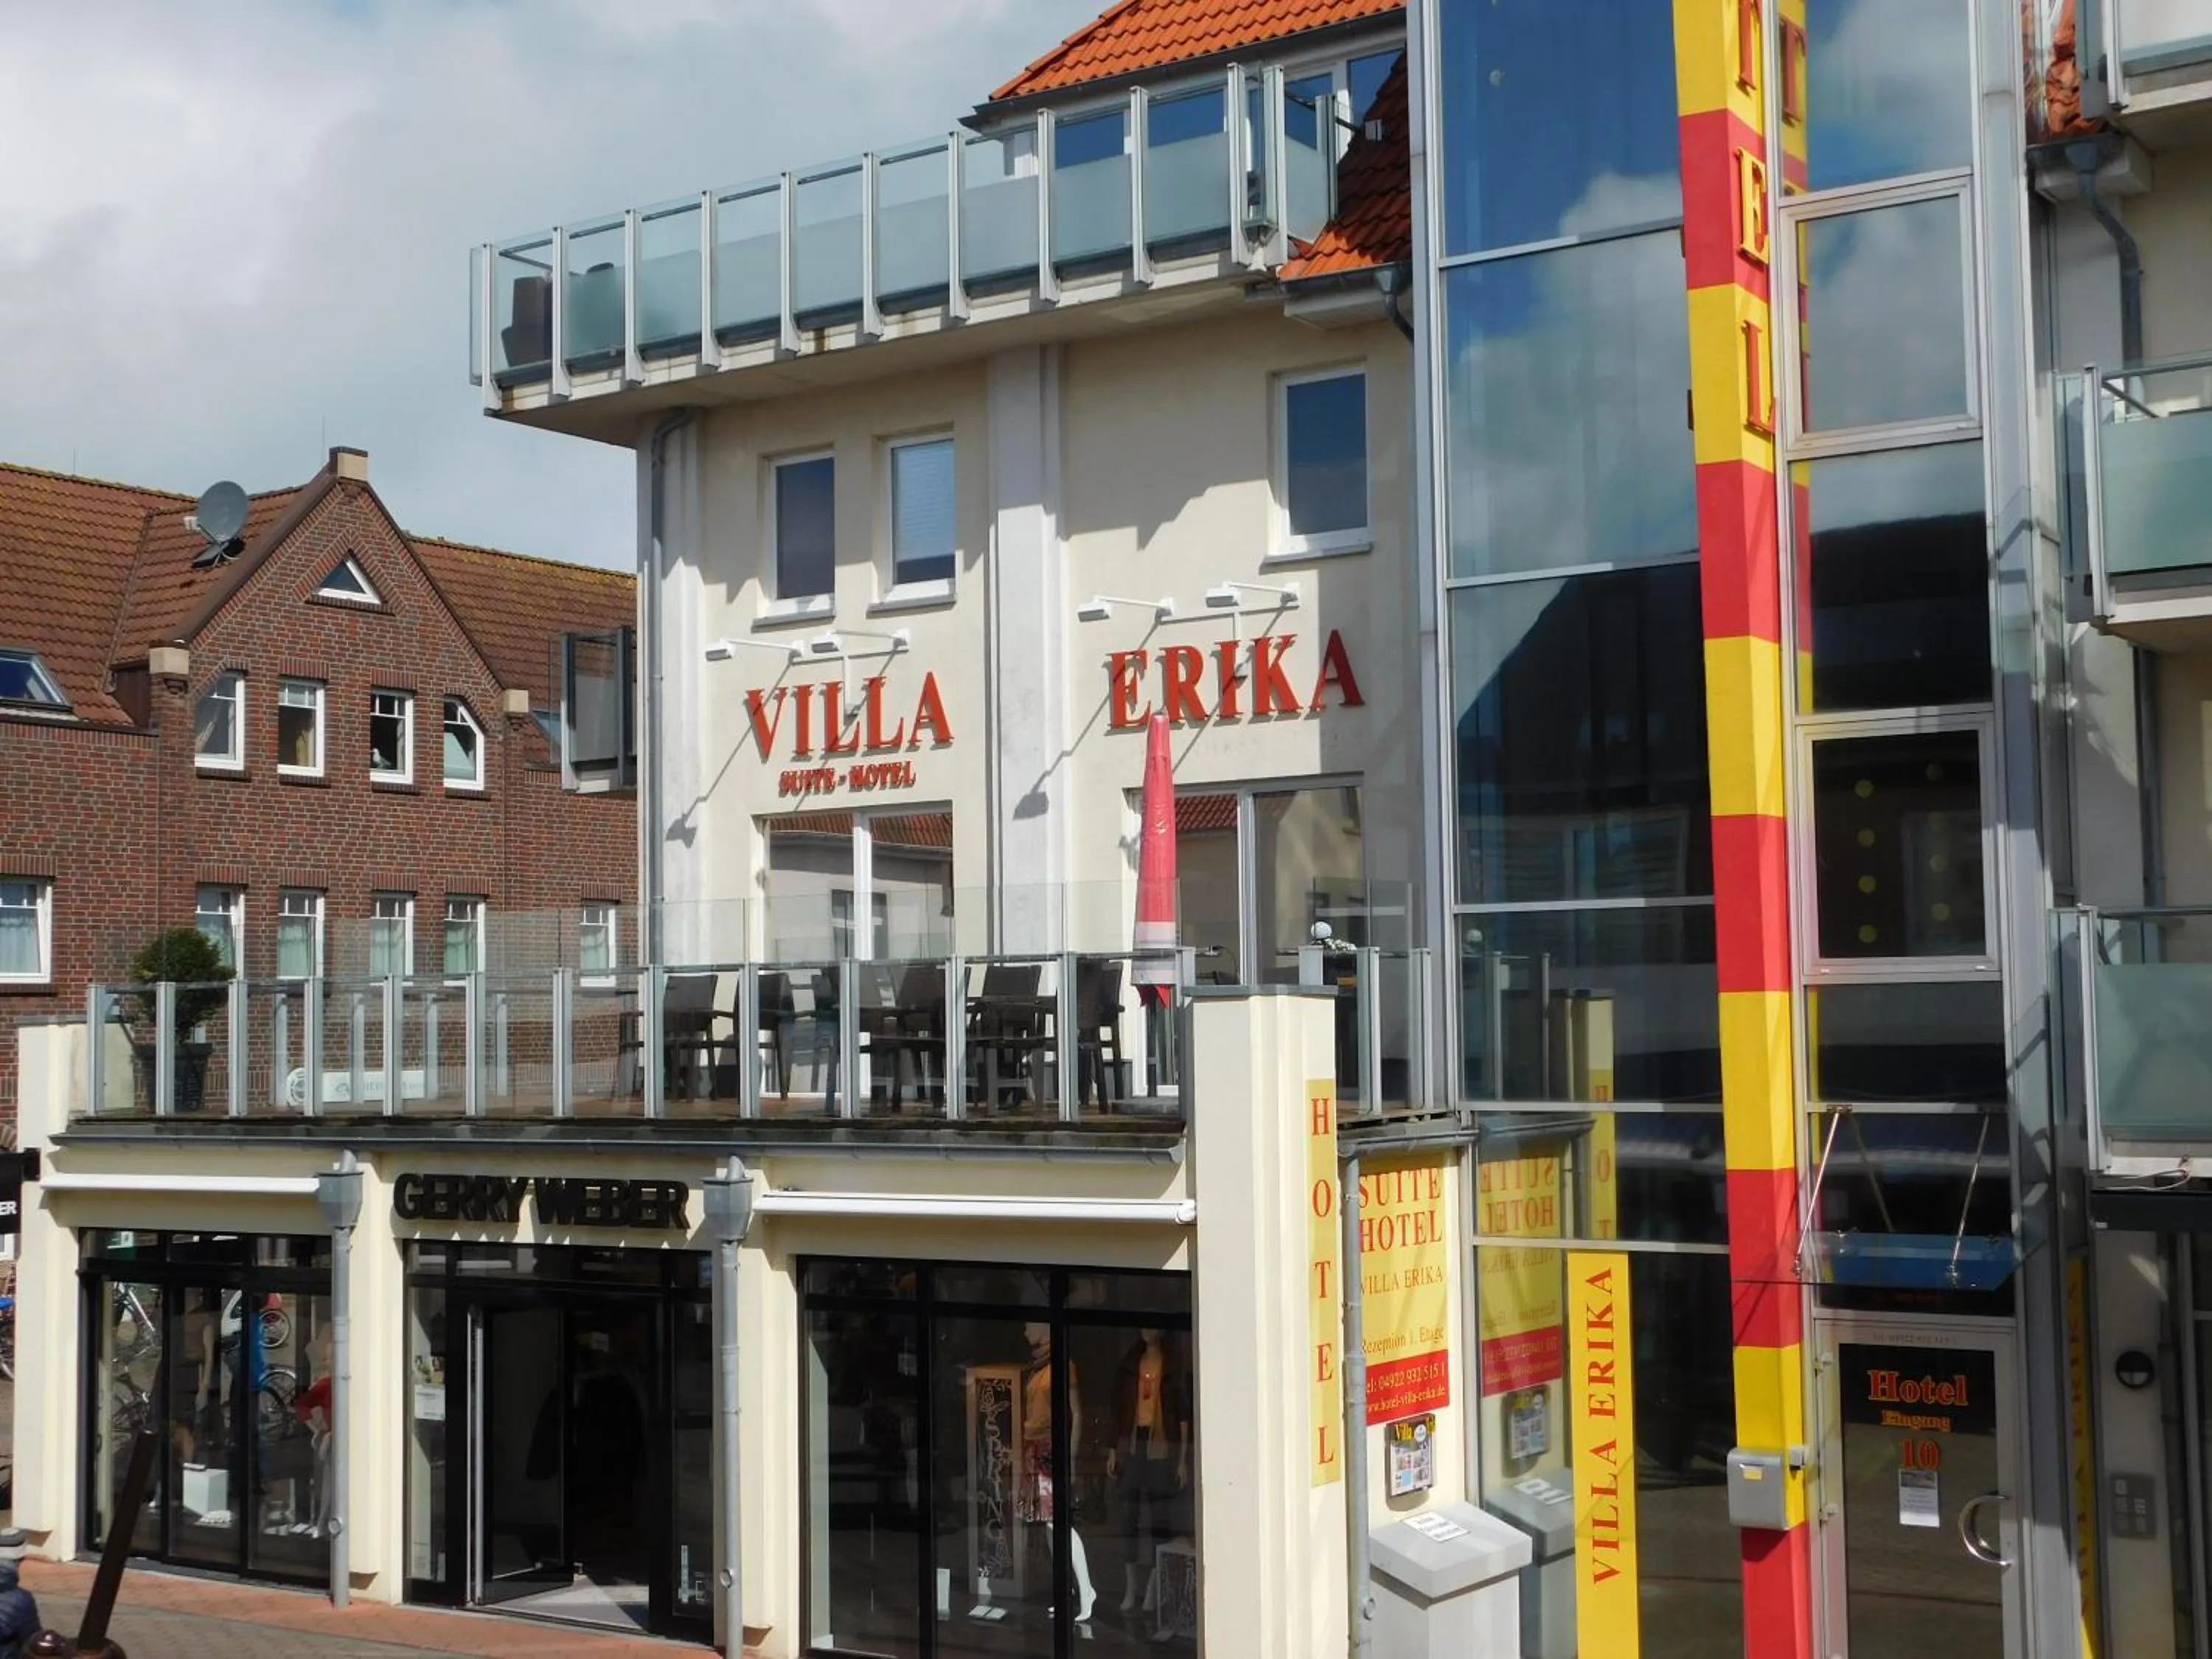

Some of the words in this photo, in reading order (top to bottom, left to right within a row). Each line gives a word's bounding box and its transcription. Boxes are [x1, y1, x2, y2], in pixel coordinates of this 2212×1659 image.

[745, 672, 954, 760] VILLA
[1106, 629, 1365, 728] ERIKA
[779, 768, 836, 796] SUITE
[849, 761, 916, 789] HOTEL
[394, 1173, 531, 1223] GERRY
[534, 1178, 691, 1229] WEBER
[1359, 1167, 1441, 1209] SUITE
[1359, 1210, 1443, 1253] HOTEL
[1311, 1097, 1334, 1466] HOTEL
[1404, 1265, 1444, 1288] ERIKA
[1585, 1267, 1616, 1417] ERIKA
[1867, 1369, 1969, 1406] Hotel
[1900, 1438, 1941, 1470] 10
[1589, 1438, 1621, 1585] VILLA
